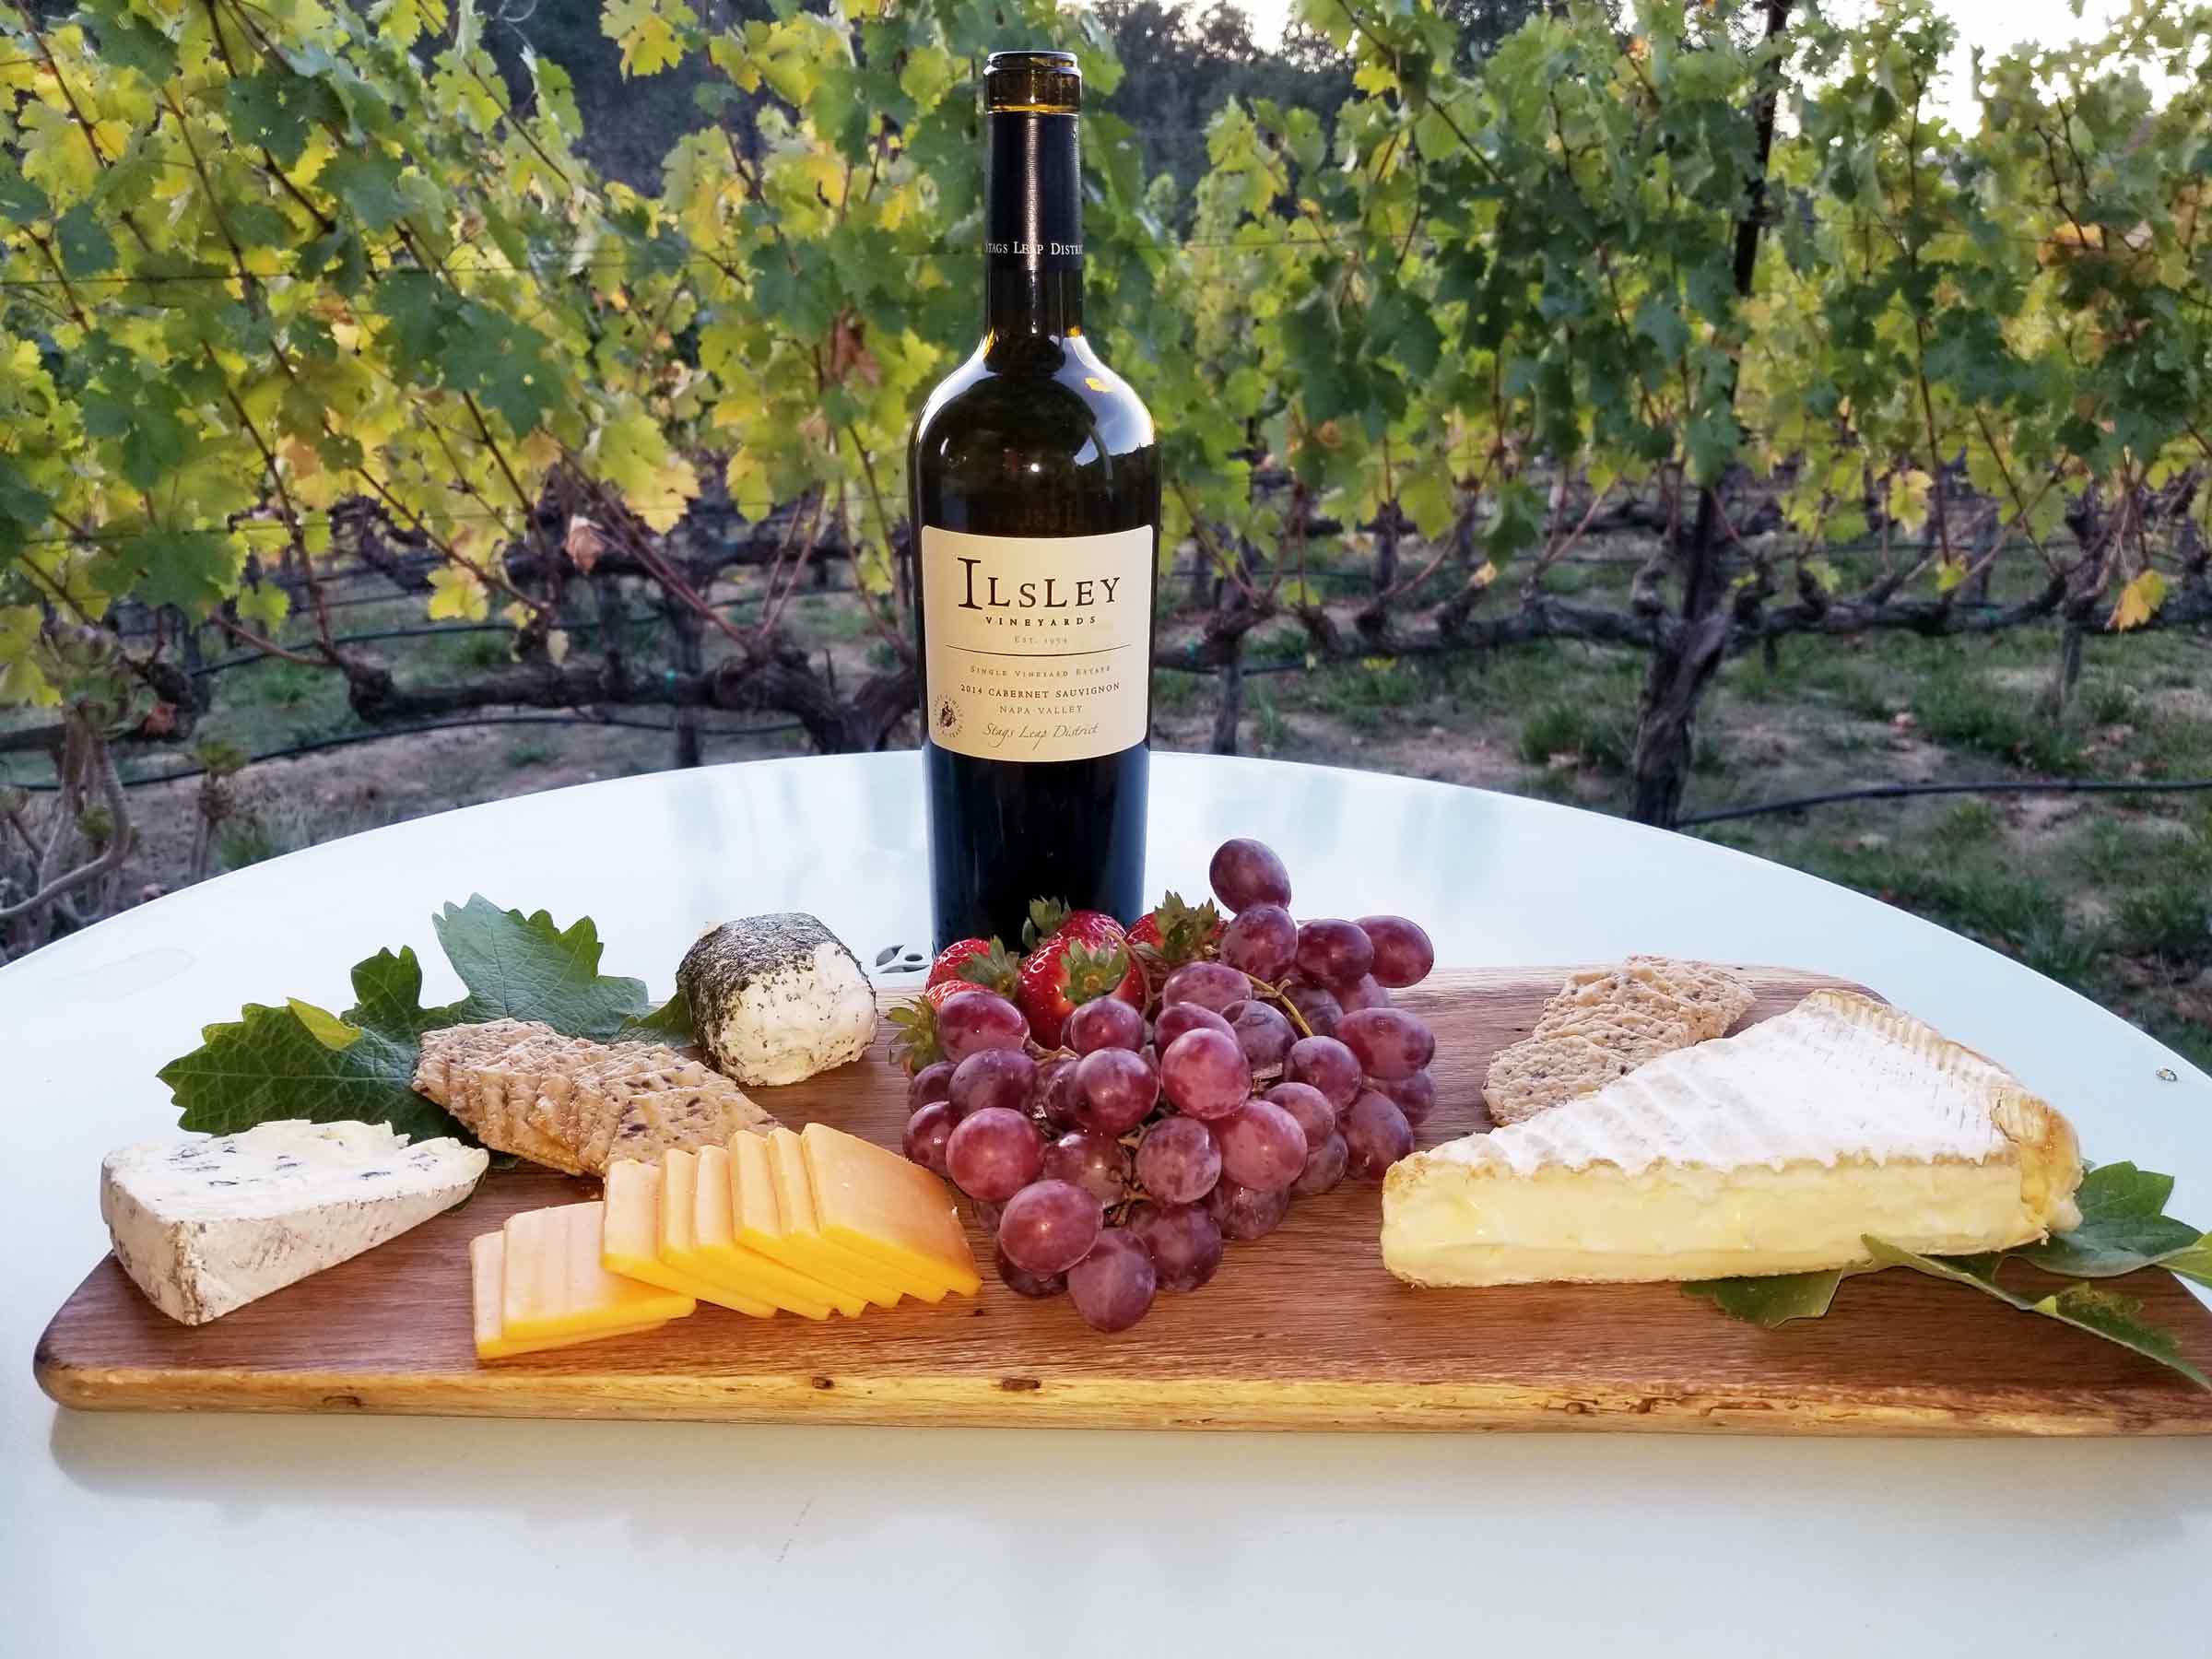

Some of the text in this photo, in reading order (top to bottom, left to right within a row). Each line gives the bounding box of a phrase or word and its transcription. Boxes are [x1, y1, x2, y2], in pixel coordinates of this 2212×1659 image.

[1013, 241, 1044, 255] LEAP
[957, 557, 1121, 610] ILSLEY
[984, 616, 1098, 628] VINEYARDS
[971, 665, 1007, 677] SINGLE
[1015, 670, 1069, 678] VINEYARD
[959, 681, 1121, 700] 2014 CABERNET SAUVIGNON
[999, 704, 1084, 715] NAPA VALLEY
[982, 722, 1100, 752] Stags Leap District
